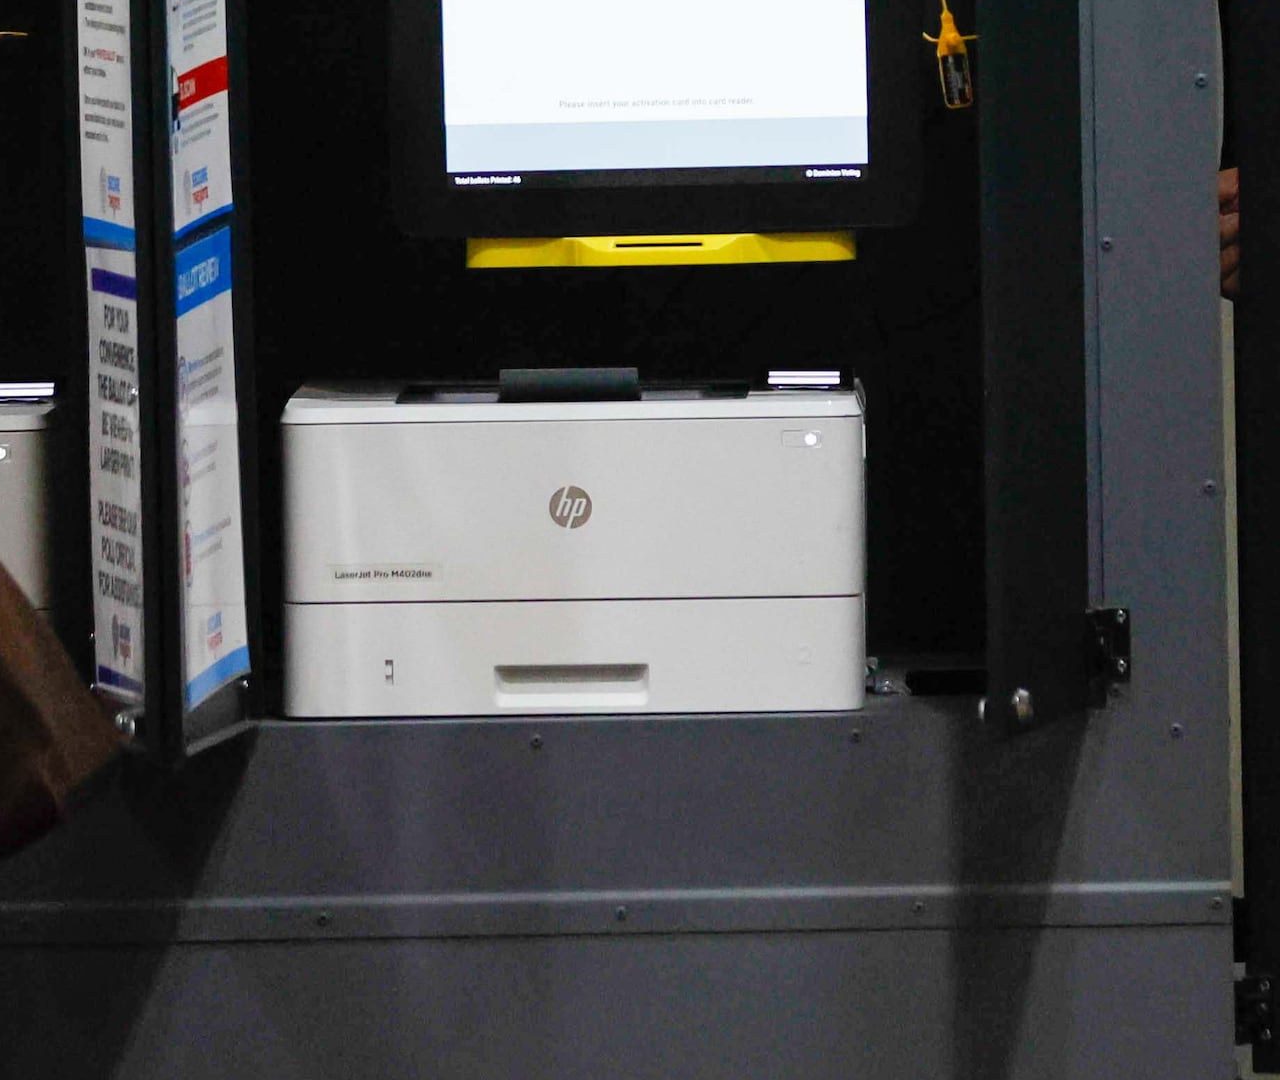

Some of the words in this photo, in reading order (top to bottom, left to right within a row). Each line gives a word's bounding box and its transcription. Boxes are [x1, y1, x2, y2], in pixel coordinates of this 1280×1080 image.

[559, 99, 585, 108] Please
[587, 98, 610, 108] insert
[612, 100, 629, 110] your
[631, 97, 670, 107] activation
[672, 98, 690, 107] card
[691, 97, 707, 106] into
[708, 96, 727, 106] card
[813, 169, 841, 178] Dominion
[841, 169, 861, 178] Voting
[454, 176, 470, 185] Total
[104, 304, 115, 330] FOR
[552, 486, 591, 529] hp
[334, 570, 371, 579] LaserJet
[374, 570, 389, 578] Pro
